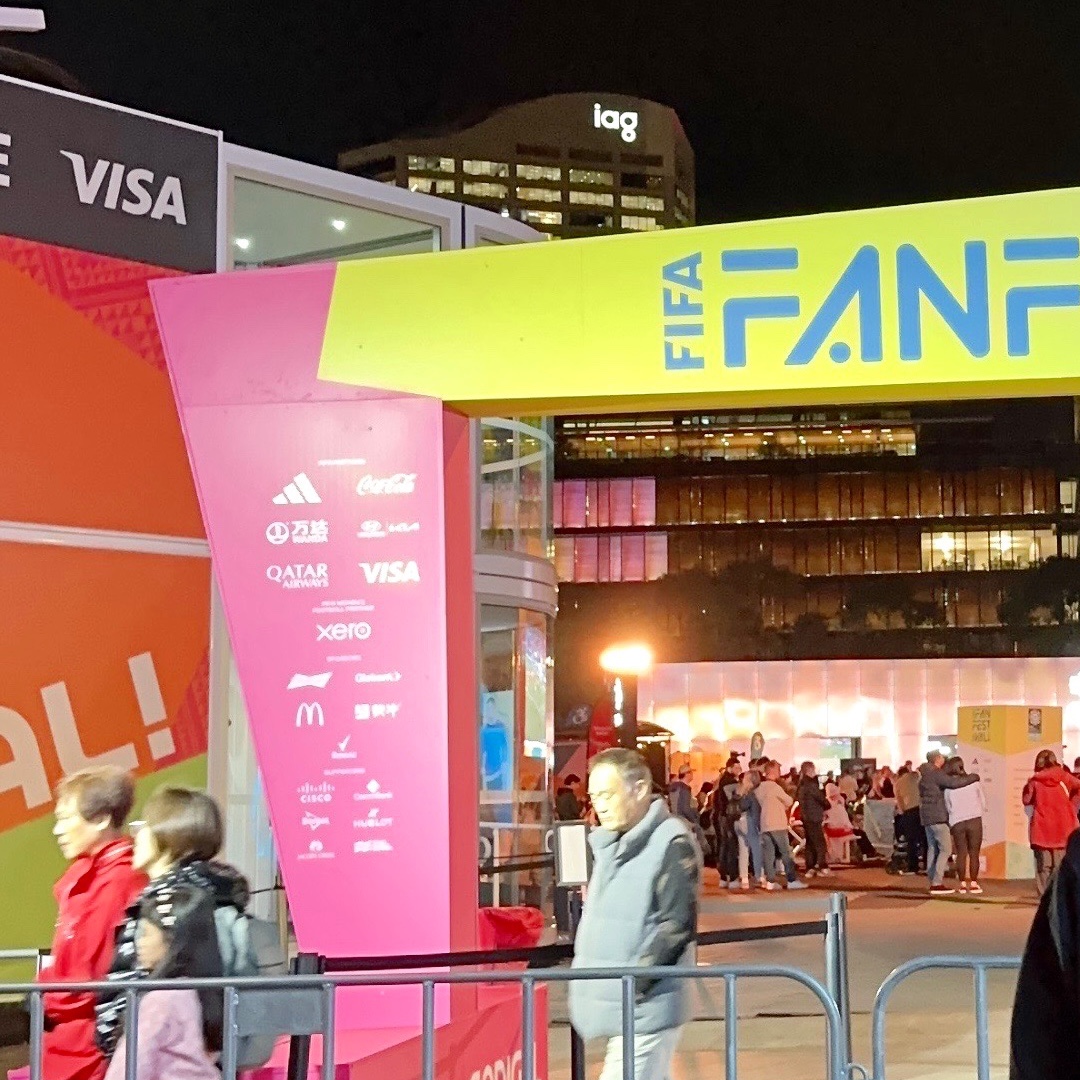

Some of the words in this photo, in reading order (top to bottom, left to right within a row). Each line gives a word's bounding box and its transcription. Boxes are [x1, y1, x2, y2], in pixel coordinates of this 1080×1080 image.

[593, 102, 639, 143] iag
[60, 150, 187, 226] VISA
[662, 251, 704, 371] FIFA
[266, 562, 328, 583] QATAR
[358, 560, 421, 584] VISA
[316, 621, 372, 641] xero
